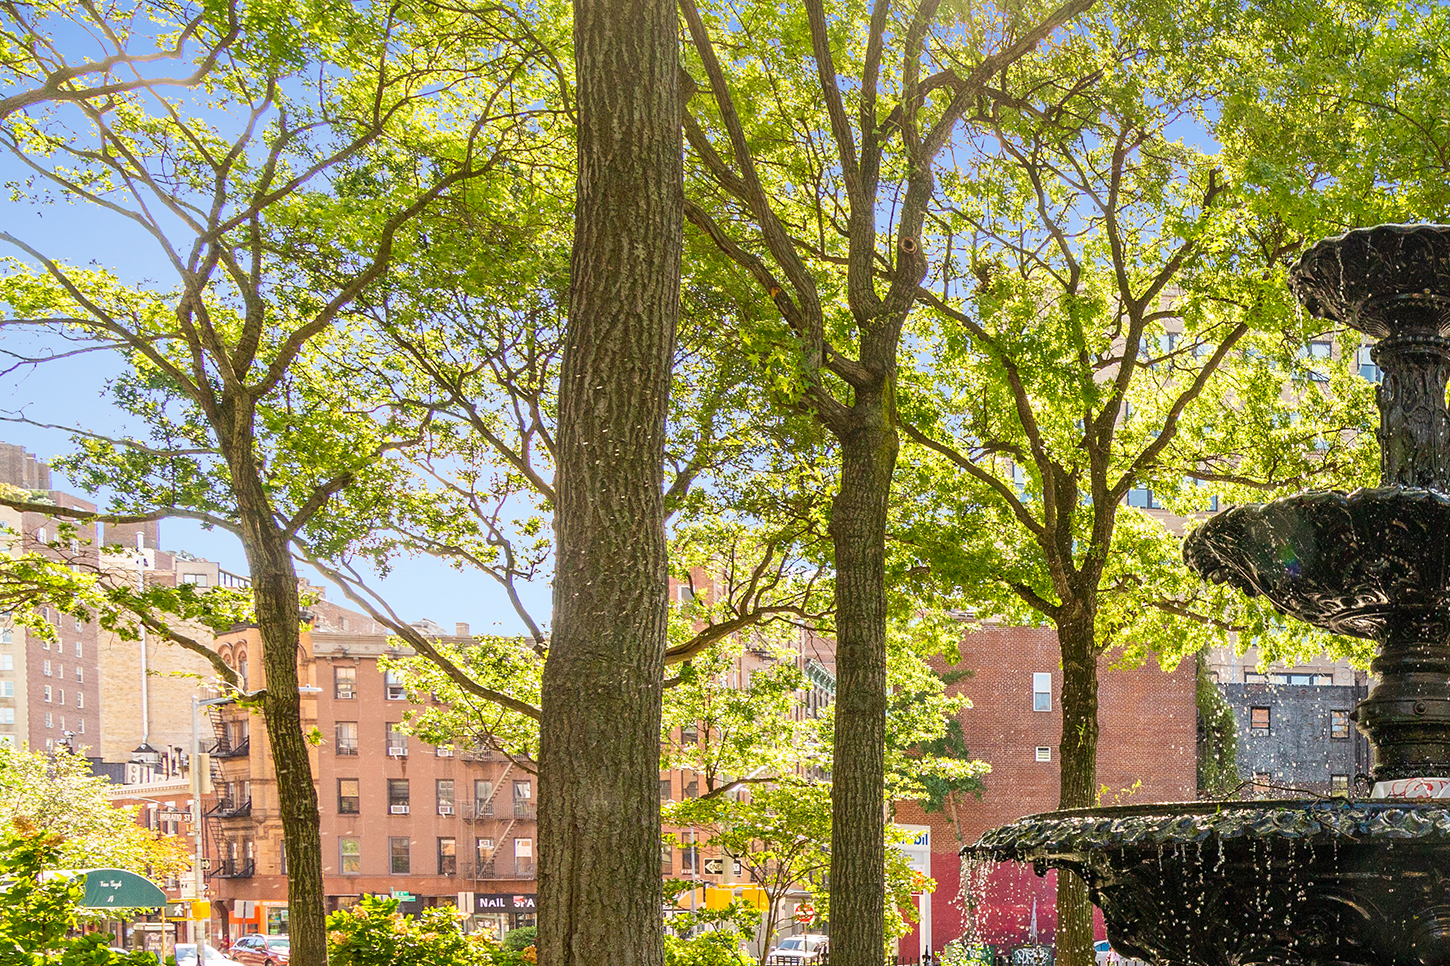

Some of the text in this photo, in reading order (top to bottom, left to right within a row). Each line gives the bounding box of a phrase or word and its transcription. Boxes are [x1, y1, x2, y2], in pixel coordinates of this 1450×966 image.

[160, 813, 191, 821] HORATIO ST
[480, 898, 505, 907] NAIL
